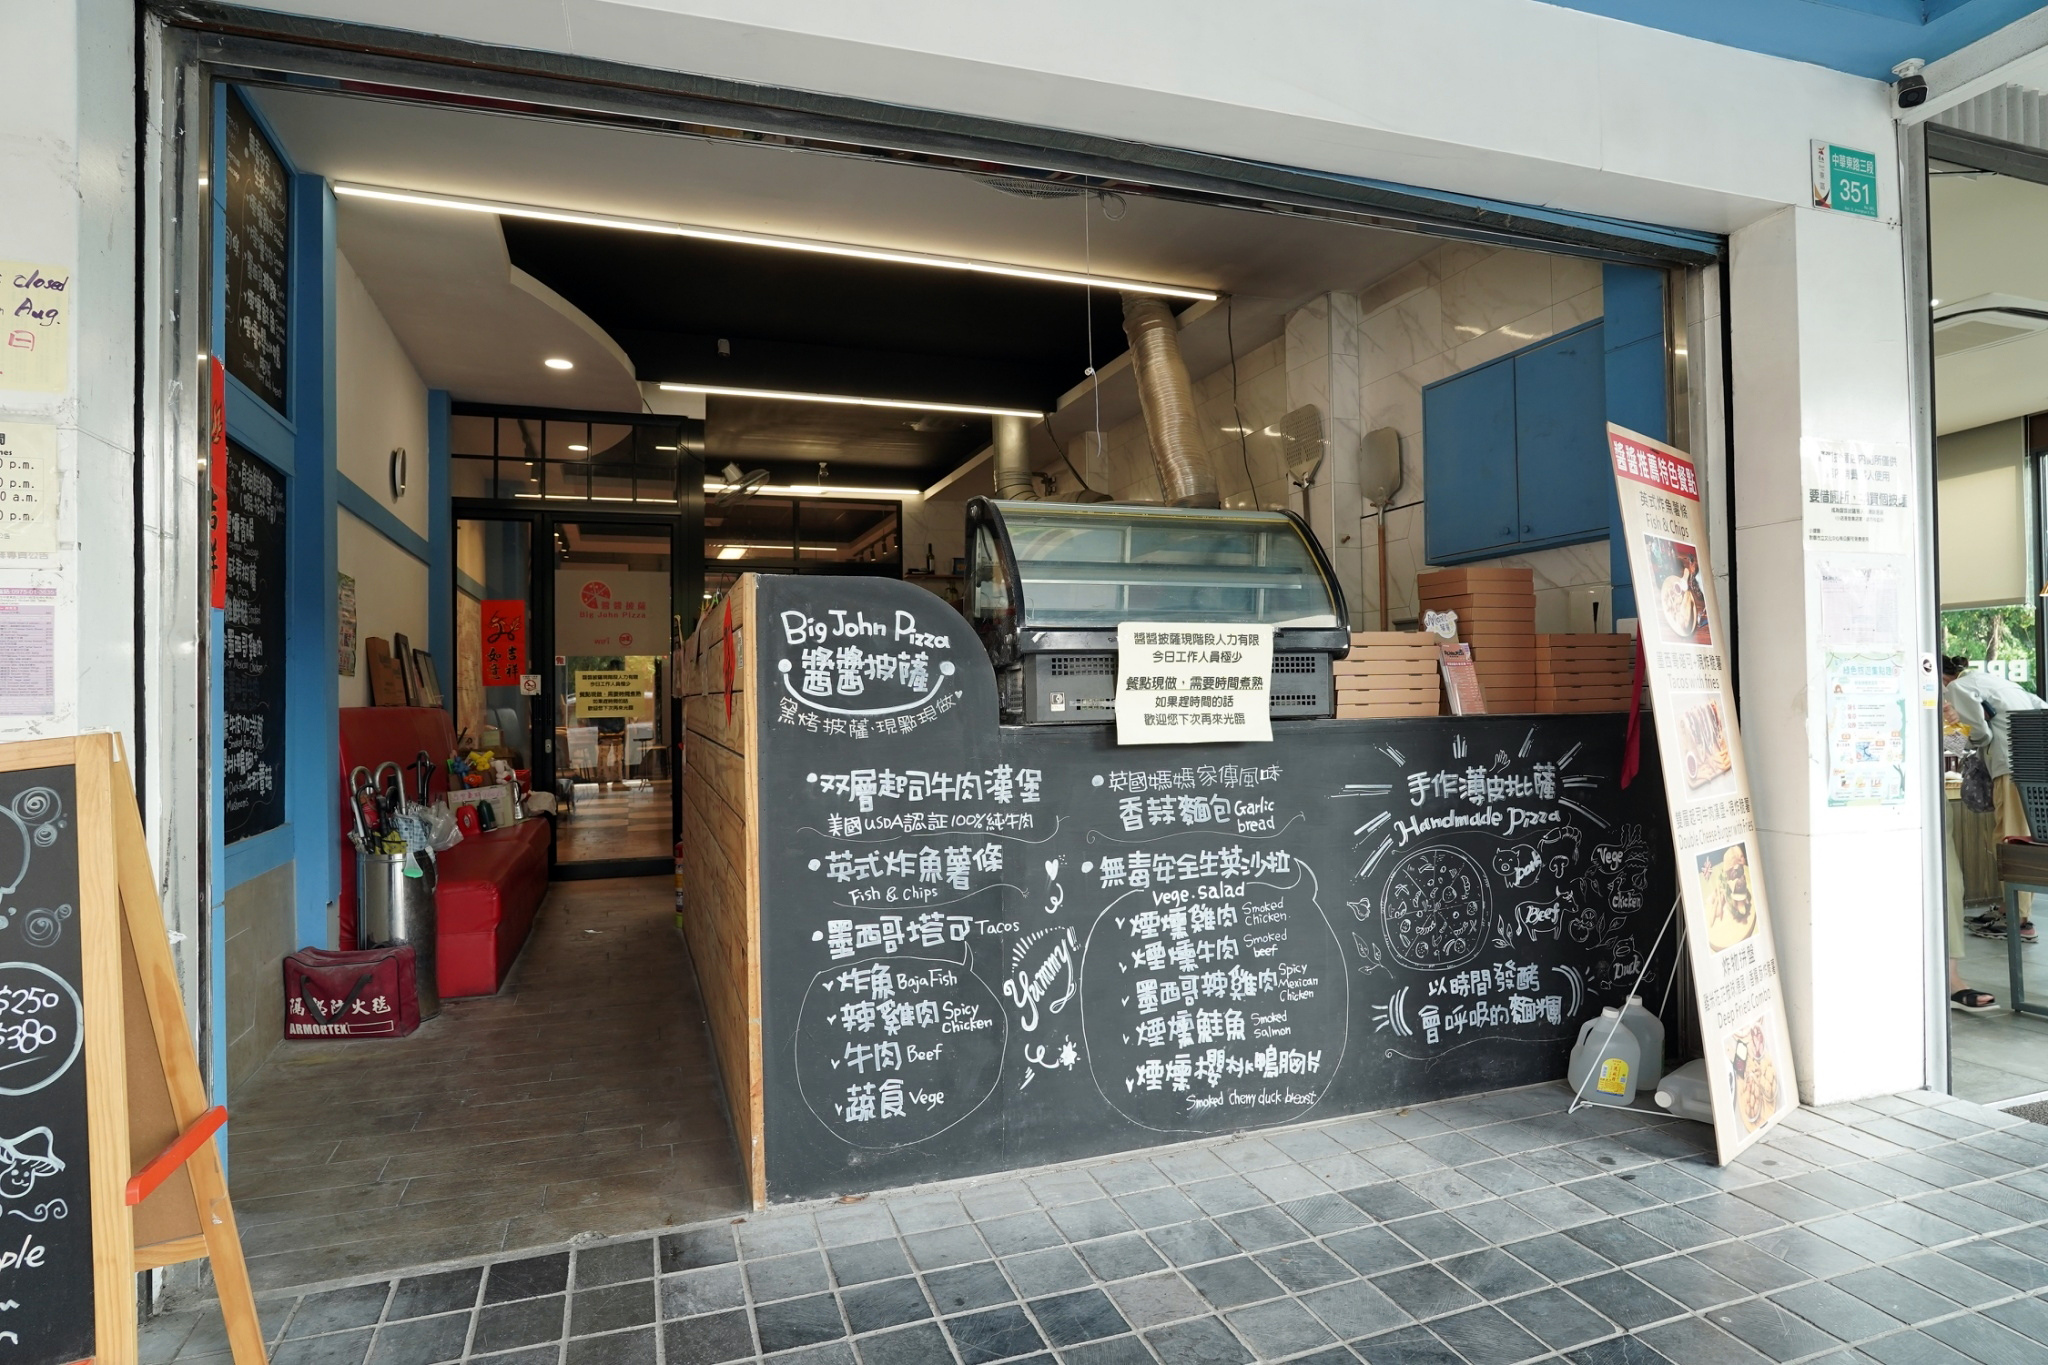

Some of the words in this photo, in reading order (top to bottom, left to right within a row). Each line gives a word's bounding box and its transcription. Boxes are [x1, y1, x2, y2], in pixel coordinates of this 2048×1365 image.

[1832, 153, 1874, 175] 中華東路三段
[1840, 179, 1869, 205] 351
[13, 269, 69, 292] closed
[14, 297, 60, 326] Aug.
[9, 461, 35, 470] p.m.
[1613, 440, 1698, 496] 醬醬推薦特色餐點
[9, 480, 35, 489] p.m.
[12, 493, 38, 502] a.m.
[9, 512, 35, 521] p.m.
[1646, 513, 1660, 530] Fish
[1662, 518, 1669, 532] &
[1669, 519, 1689, 540] Chips
[579, 611, 594, 619] Big
[597, 611, 618, 619] John
[622, 611, 647, 619] Pizza
[780, 610, 827, 645] Big
[828, 610, 887, 637] John
[894, 610, 951, 649] Pizza
[1134, 632, 1259, 647] 醬醬披薩現階段人力有限
[487, 647, 502, 679] 如意
[505, 646, 519, 679] 吉祥
[1152, 650, 1242, 664] 今日工作人員極少
[802, 645, 930, 696] 醬醬披薩
[1126, 676, 1263, 690] 餐點現做，需要時間煮熟
[1155, 695, 1234, 708] 如果趕時間的話
[1144, 712, 1245, 726] 歡迎您下次再來光臨
[820, 764, 1043, 812] 双層起司牛肉漢堡
[1108, 763, 1283, 793] 英國媽媽家傳風味
[1407, 761, 1556, 806] 手作薄皮批薩
[1119, 793, 1232, 832] 香蒜麵包
[1234, 796, 1275, 817] Garlic
[1237, 816, 1276, 834] bread
[1394, 807, 1503, 847] Handmade
[1503, 807, 1560, 836] Pizza
[825, 843, 1003, 890] 英式炸魚薯條
[1100, 844, 1291, 888] 無毒安全生菜沙拉
[1596, 847, 1624, 870] Vege
[848, 886, 881, 905] Fish
[886, 886, 898, 902] &
[903, 886, 939, 903] Chips
[1242, 897, 1284, 916] Smoked
[1129, 903, 1238, 941] 煙燻雞肉
[1526, 902, 1560, 924] Beef
[827, 911, 973, 960] 墨西哥塔可
[975, 919, 1020, 935] Tacos
[1243, 928, 1288, 948] Smoked
[1131, 935, 1240, 972] 煙燻牛肉
[1253, 945, 1279, 958] beef
[1279, 963, 1308, 979] Spicy
[1428, 960, 1540, 997] 以時間發酵
[1613, 955, 1640, 980] Duck
[836, 962, 895, 1001] 炸魚
[896, 973, 929, 994] Baja
[928, 968, 958, 987] Fish
[1136, 964, 1278, 1015] 墨西哥辣雞肉
[1278, 976, 1318, 989] Mexican
[840, 999, 940, 1037] 辣雞肉
[942, 1001, 979, 1021] Spicy
[1251, 1010, 1287, 1026] Smoked
[1136, 1008, 1246, 1049] 煙燻鮭魚
[843, 1040, 903, 1074] 牛肉
[906, 1043, 944, 1063] Beef
[1136, 1044, 1322, 1092] 煙燻櫻桃鴨胸片
[845, 1078, 907, 1123] 蔬食
[908, 1088, 945, 1112] Vege
[1186, 1090, 1224, 1111] Smoked
[1258, 1088, 1282, 1104] duck
[1285, 1087, 1317, 1105] breast
